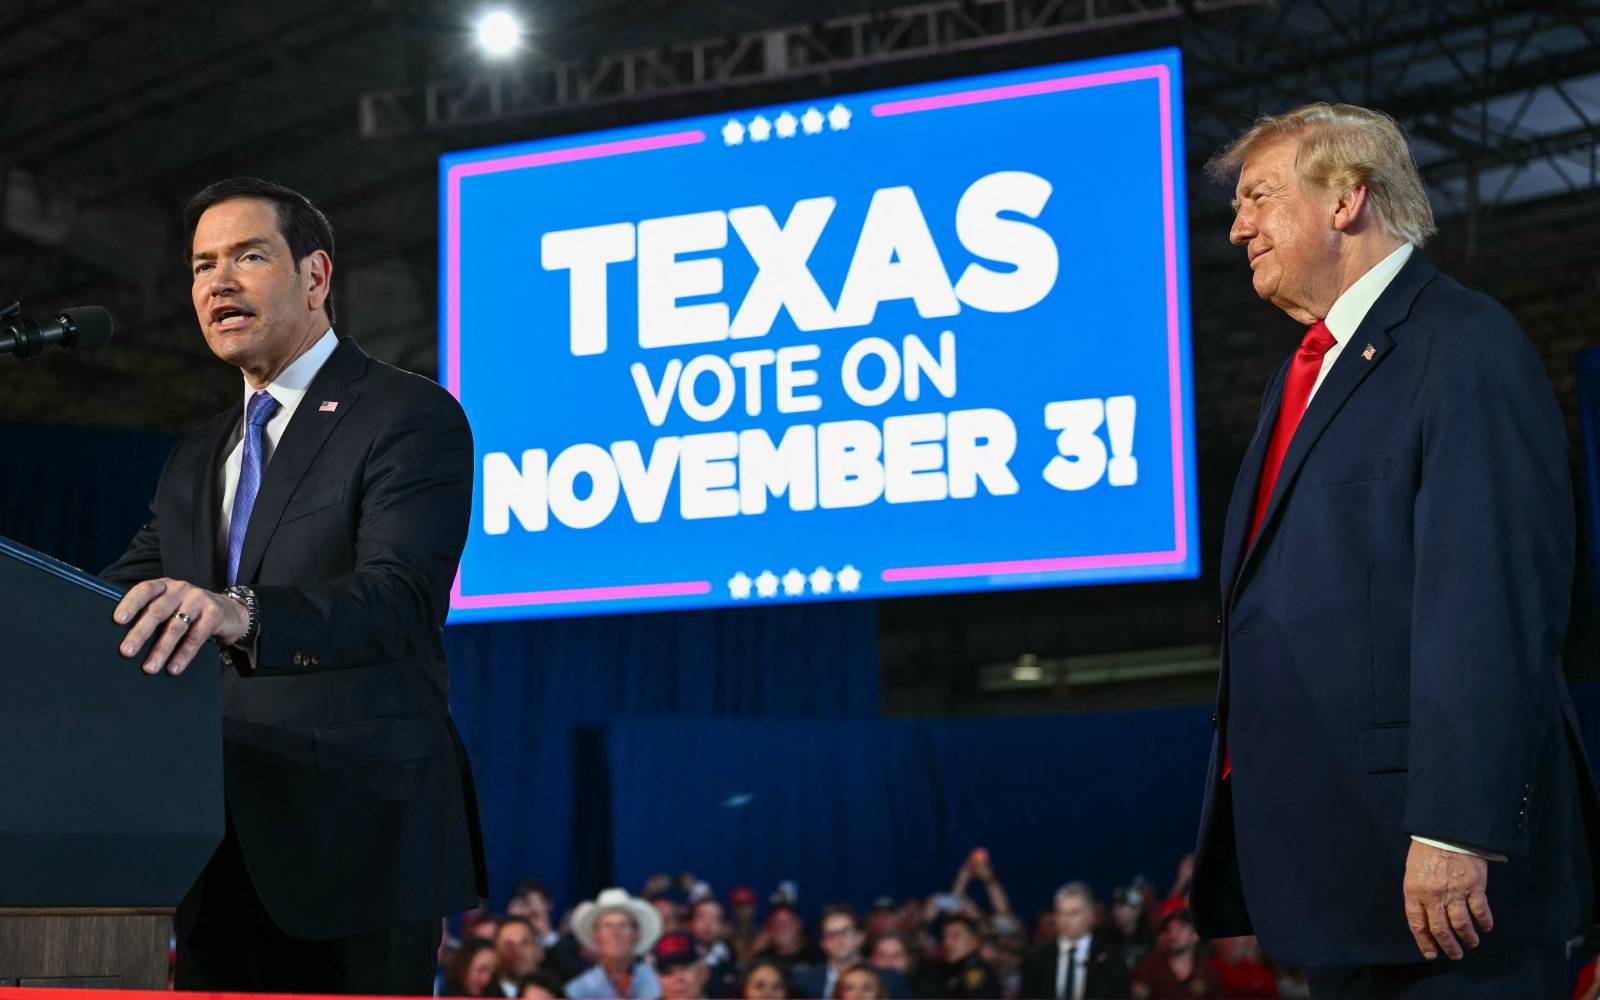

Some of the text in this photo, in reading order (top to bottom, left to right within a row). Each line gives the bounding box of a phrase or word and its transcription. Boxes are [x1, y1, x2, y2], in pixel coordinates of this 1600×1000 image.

[541, 171, 1059, 356] TEXAS
[631, 330, 956, 427] VOTE ON
[483, 395, 1138, 536] NOVEMBER 3!
